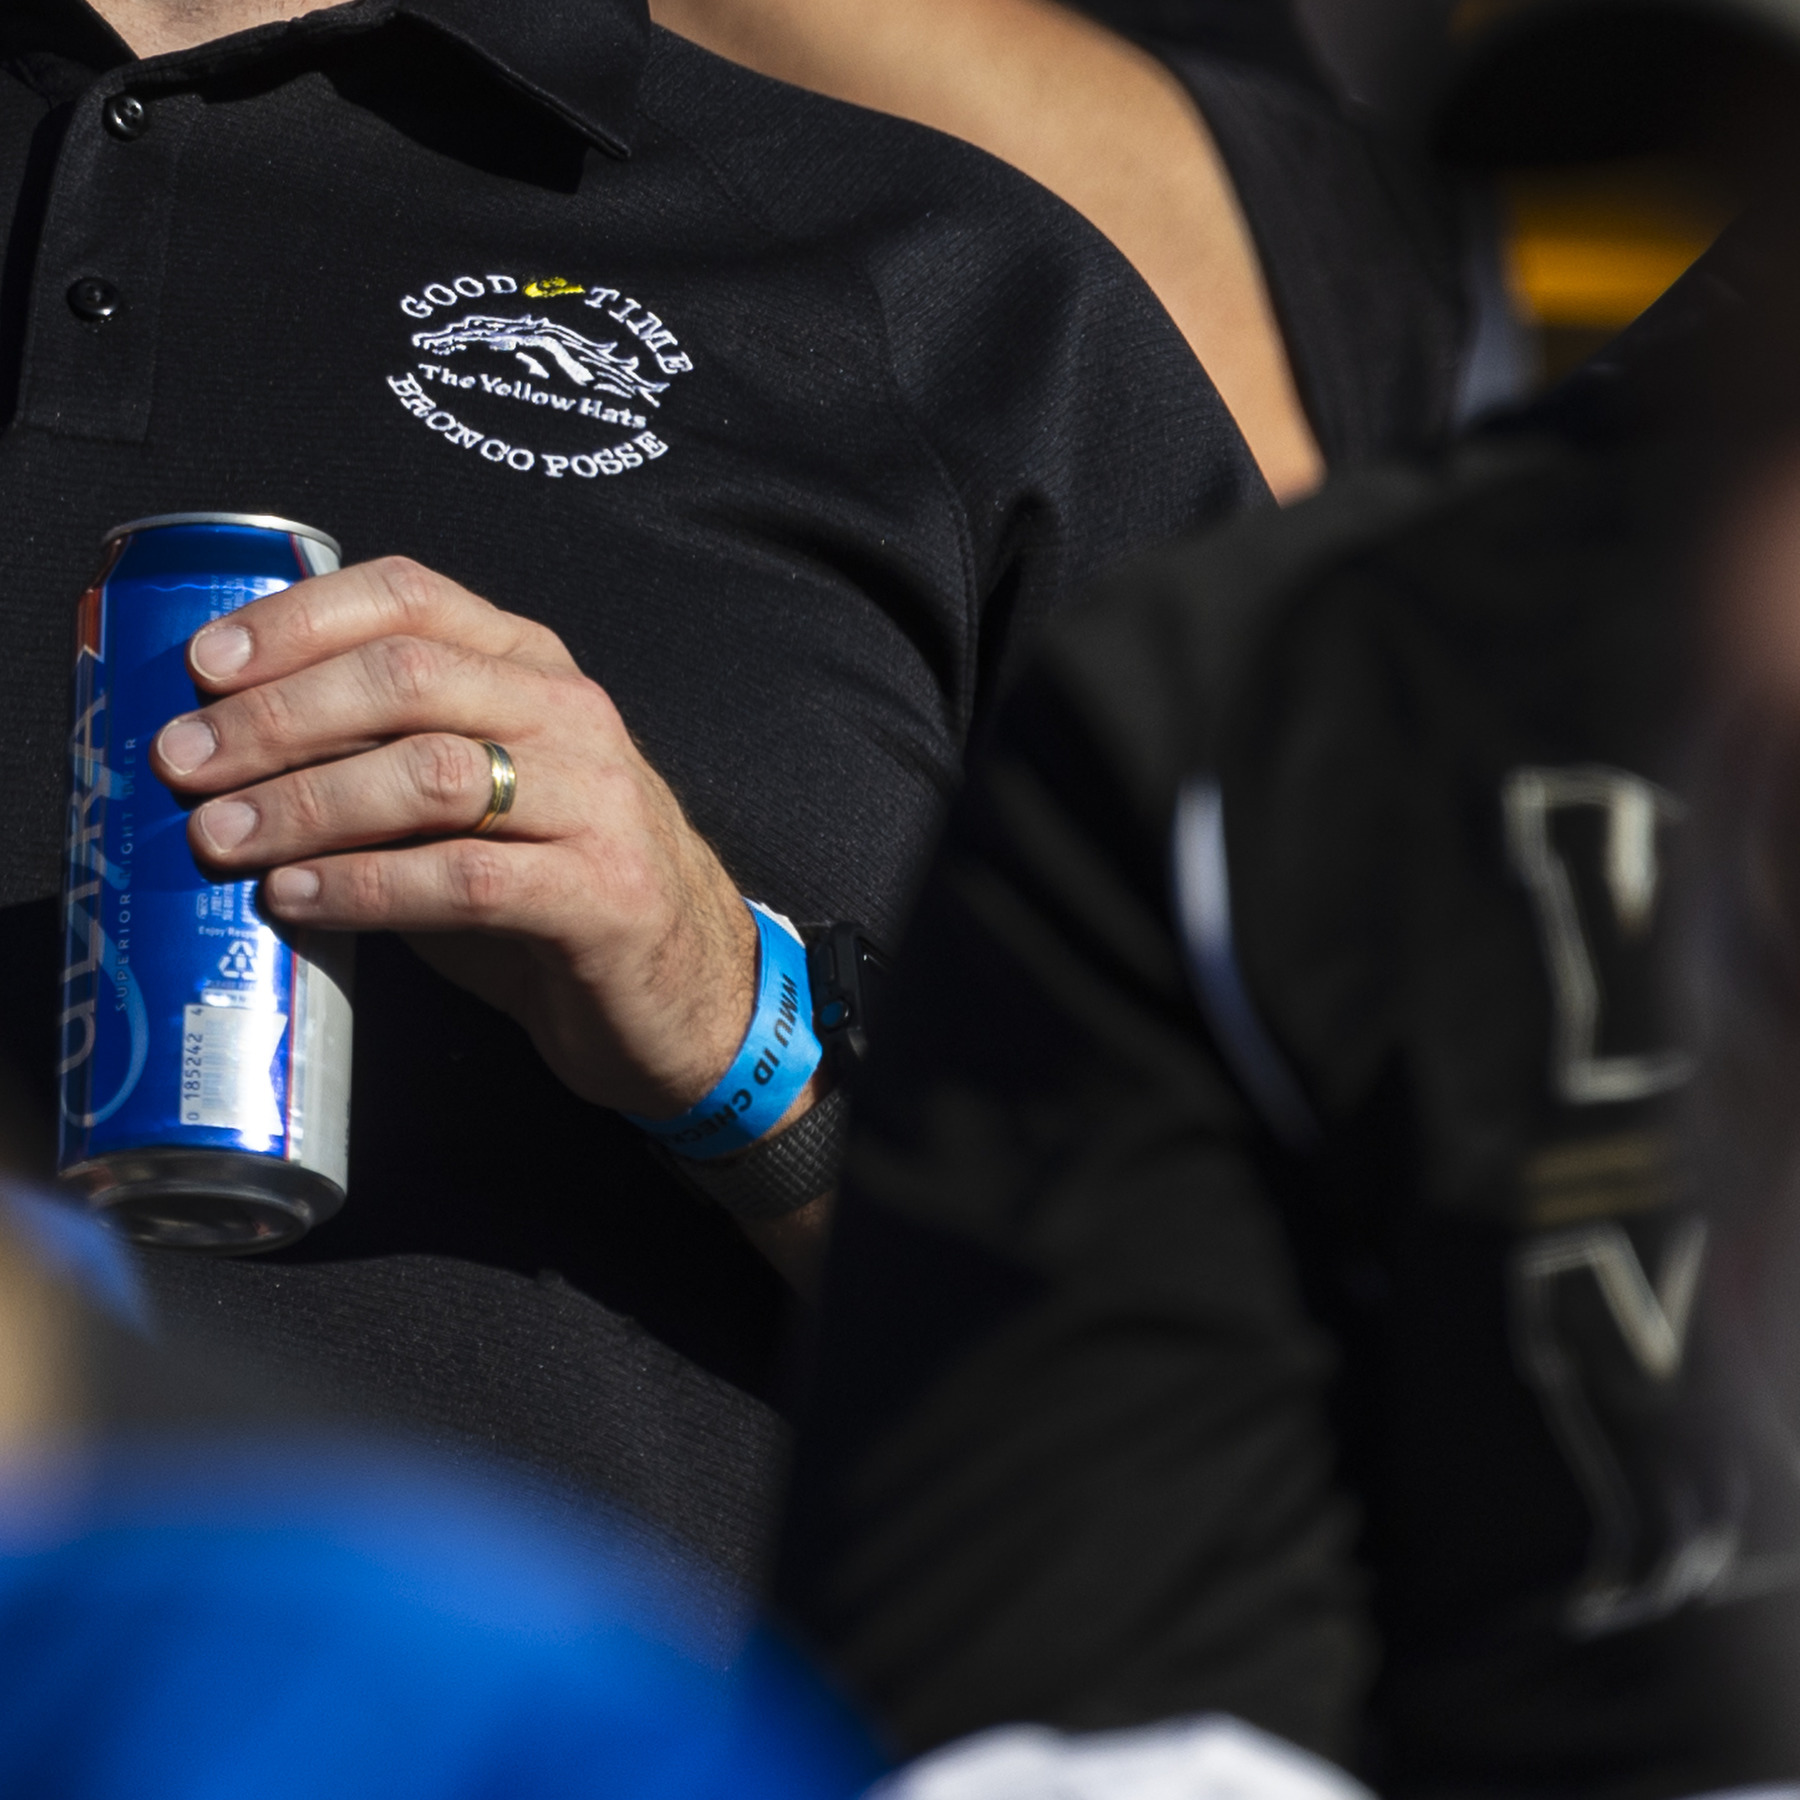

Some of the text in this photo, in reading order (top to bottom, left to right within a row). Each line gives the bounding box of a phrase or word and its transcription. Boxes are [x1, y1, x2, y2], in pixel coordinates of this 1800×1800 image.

[401, 275, 694, 374] GOOD TIME
[386, 372, 669, 478] BRONCO POSSE
[418, 363, 647, 429] The Yellow Hats
[115, 737, 137, 1012] SUPERIOR LIGHT BEER
[774, 973, 799, 1049] WMU
[183, 1032, 202, 1101] 185242
[753, 1047, 781, 1086] ID
